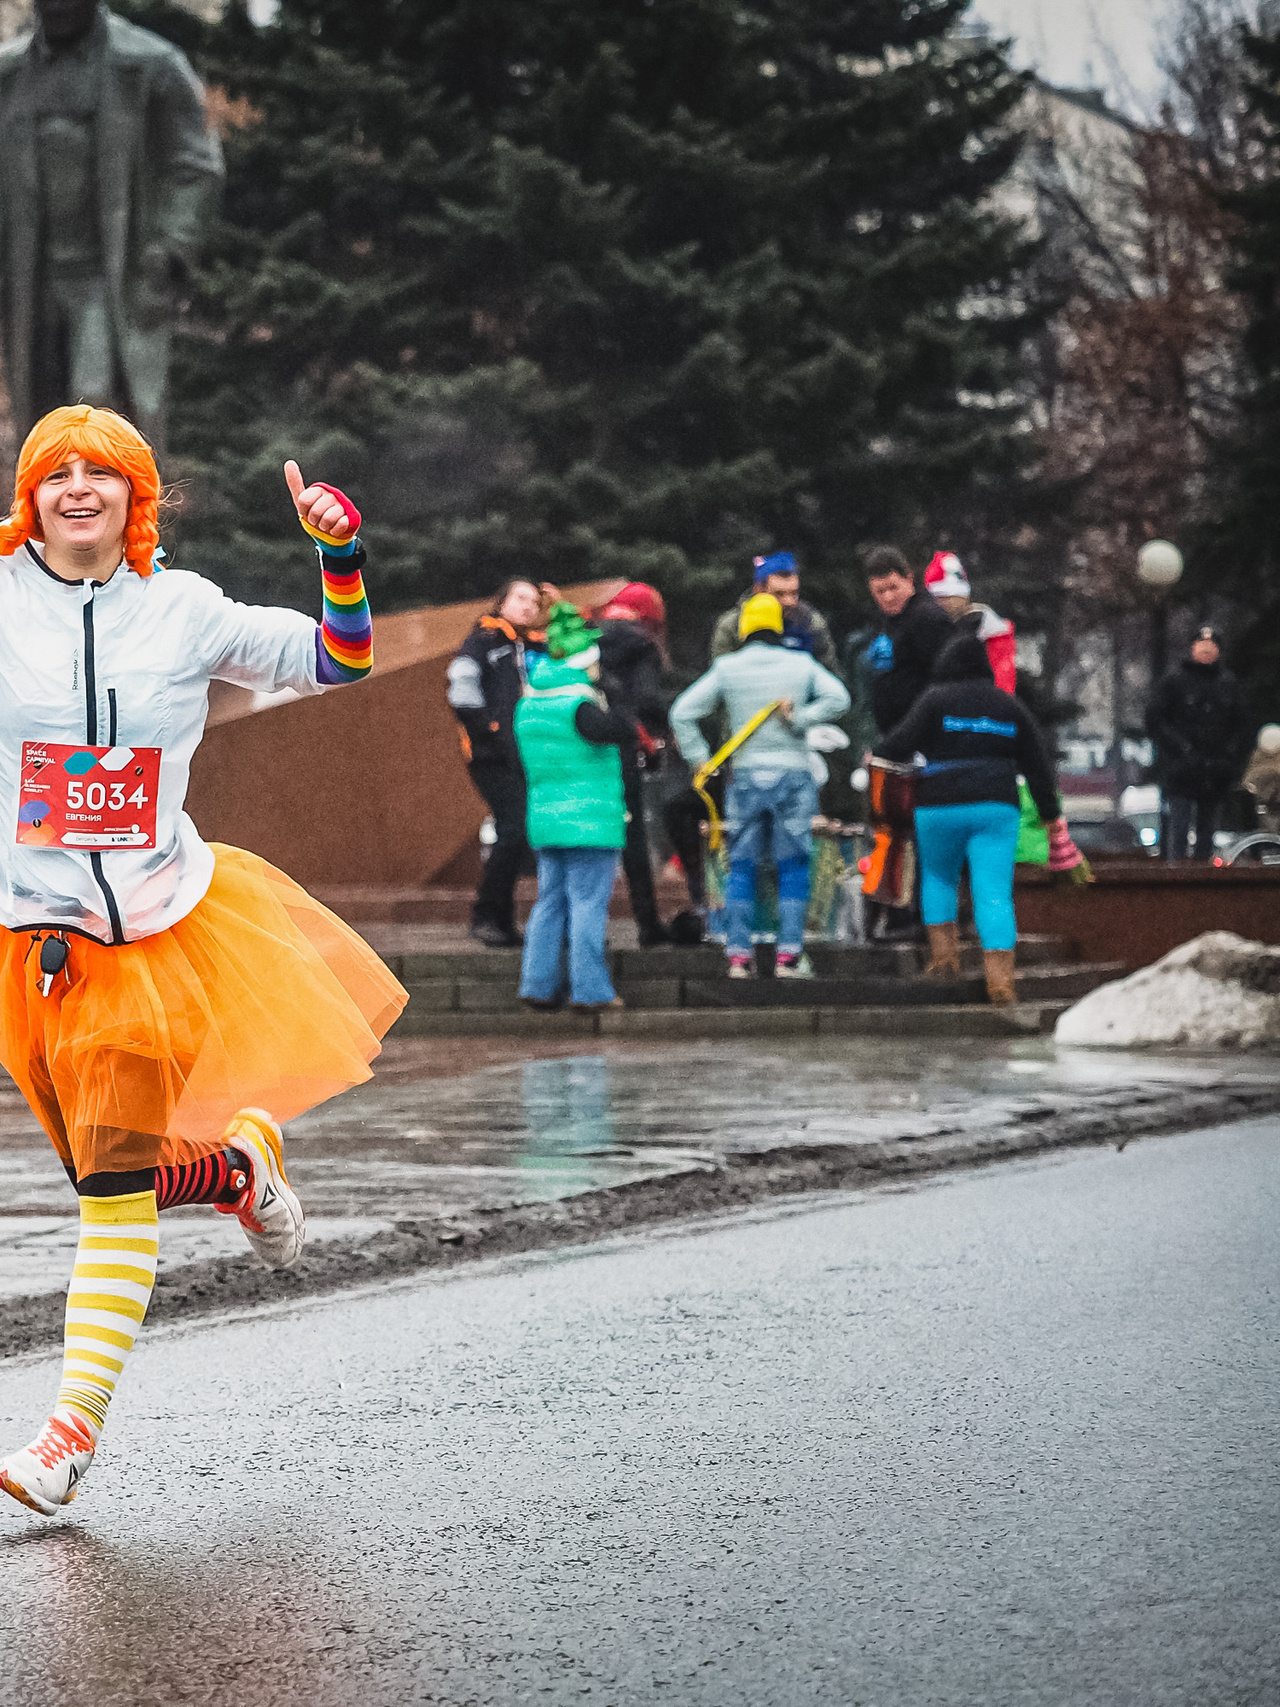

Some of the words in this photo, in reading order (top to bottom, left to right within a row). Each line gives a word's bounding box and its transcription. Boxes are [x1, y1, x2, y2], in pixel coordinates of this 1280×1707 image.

[26, 756, 56, 764] CARNIVAL
[66, 781, 149, 811] 5034
[65, 813, 102, 822] ЕВГЕНИЯ
